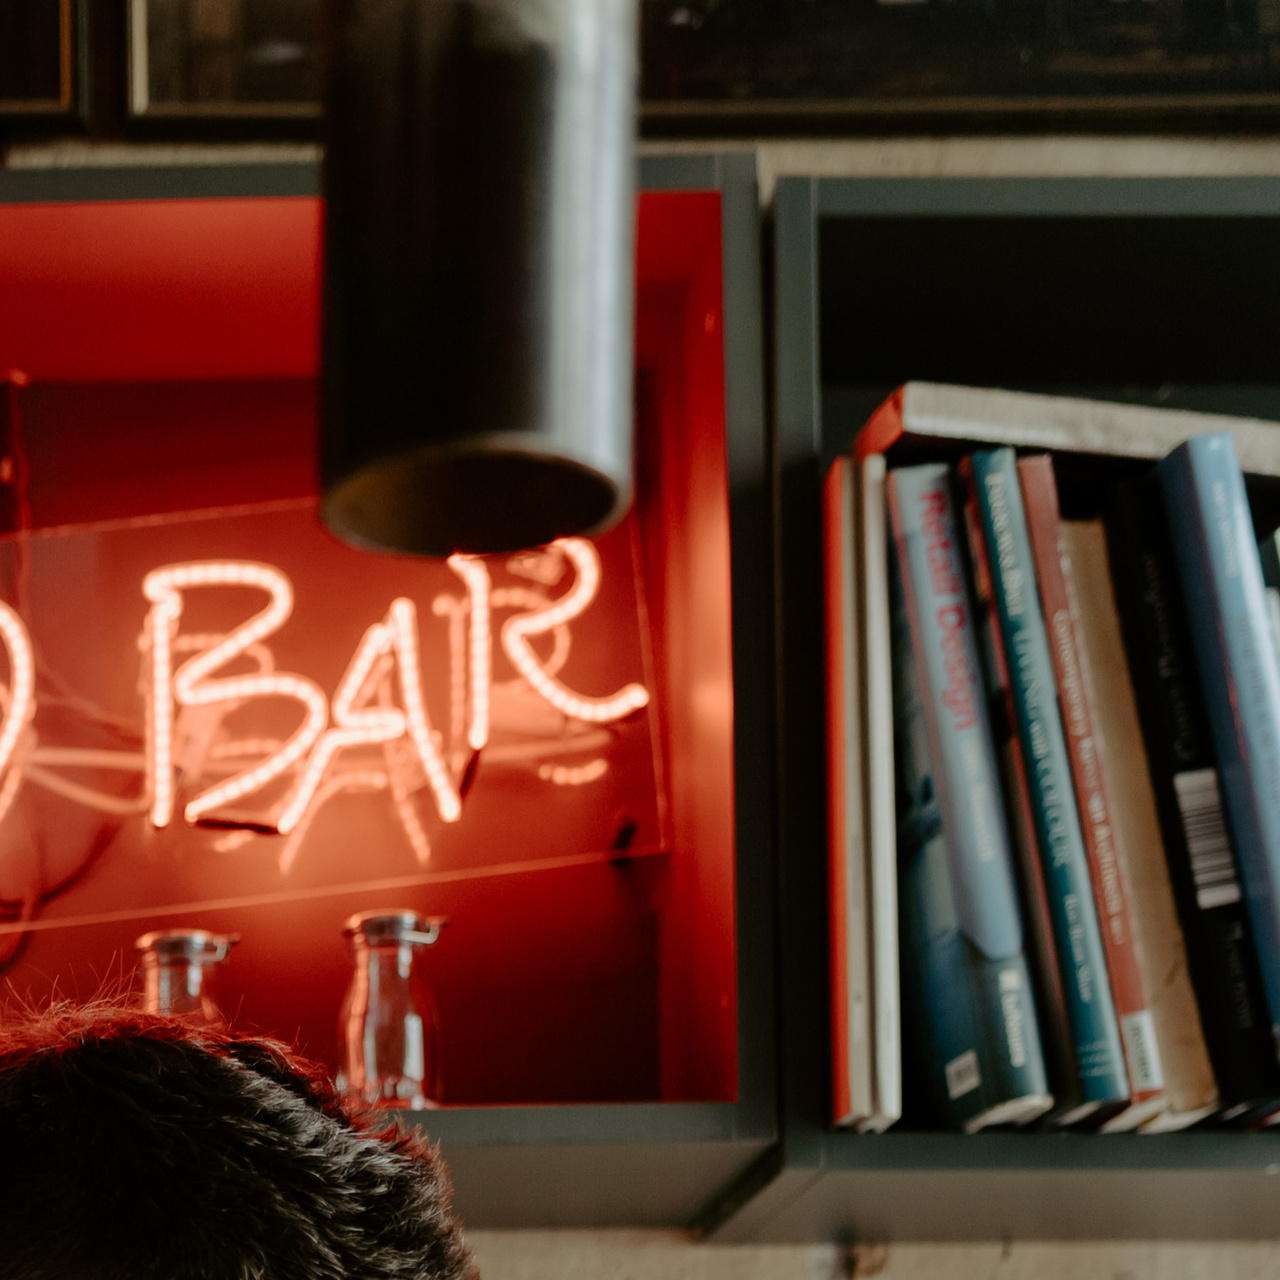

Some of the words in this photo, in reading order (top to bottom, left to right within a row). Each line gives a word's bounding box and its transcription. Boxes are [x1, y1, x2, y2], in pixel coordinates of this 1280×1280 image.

[919, 490, 962, 595] Retail
[143, 536, 650, 834] BAR
[937, 603, 977, 731] Design
